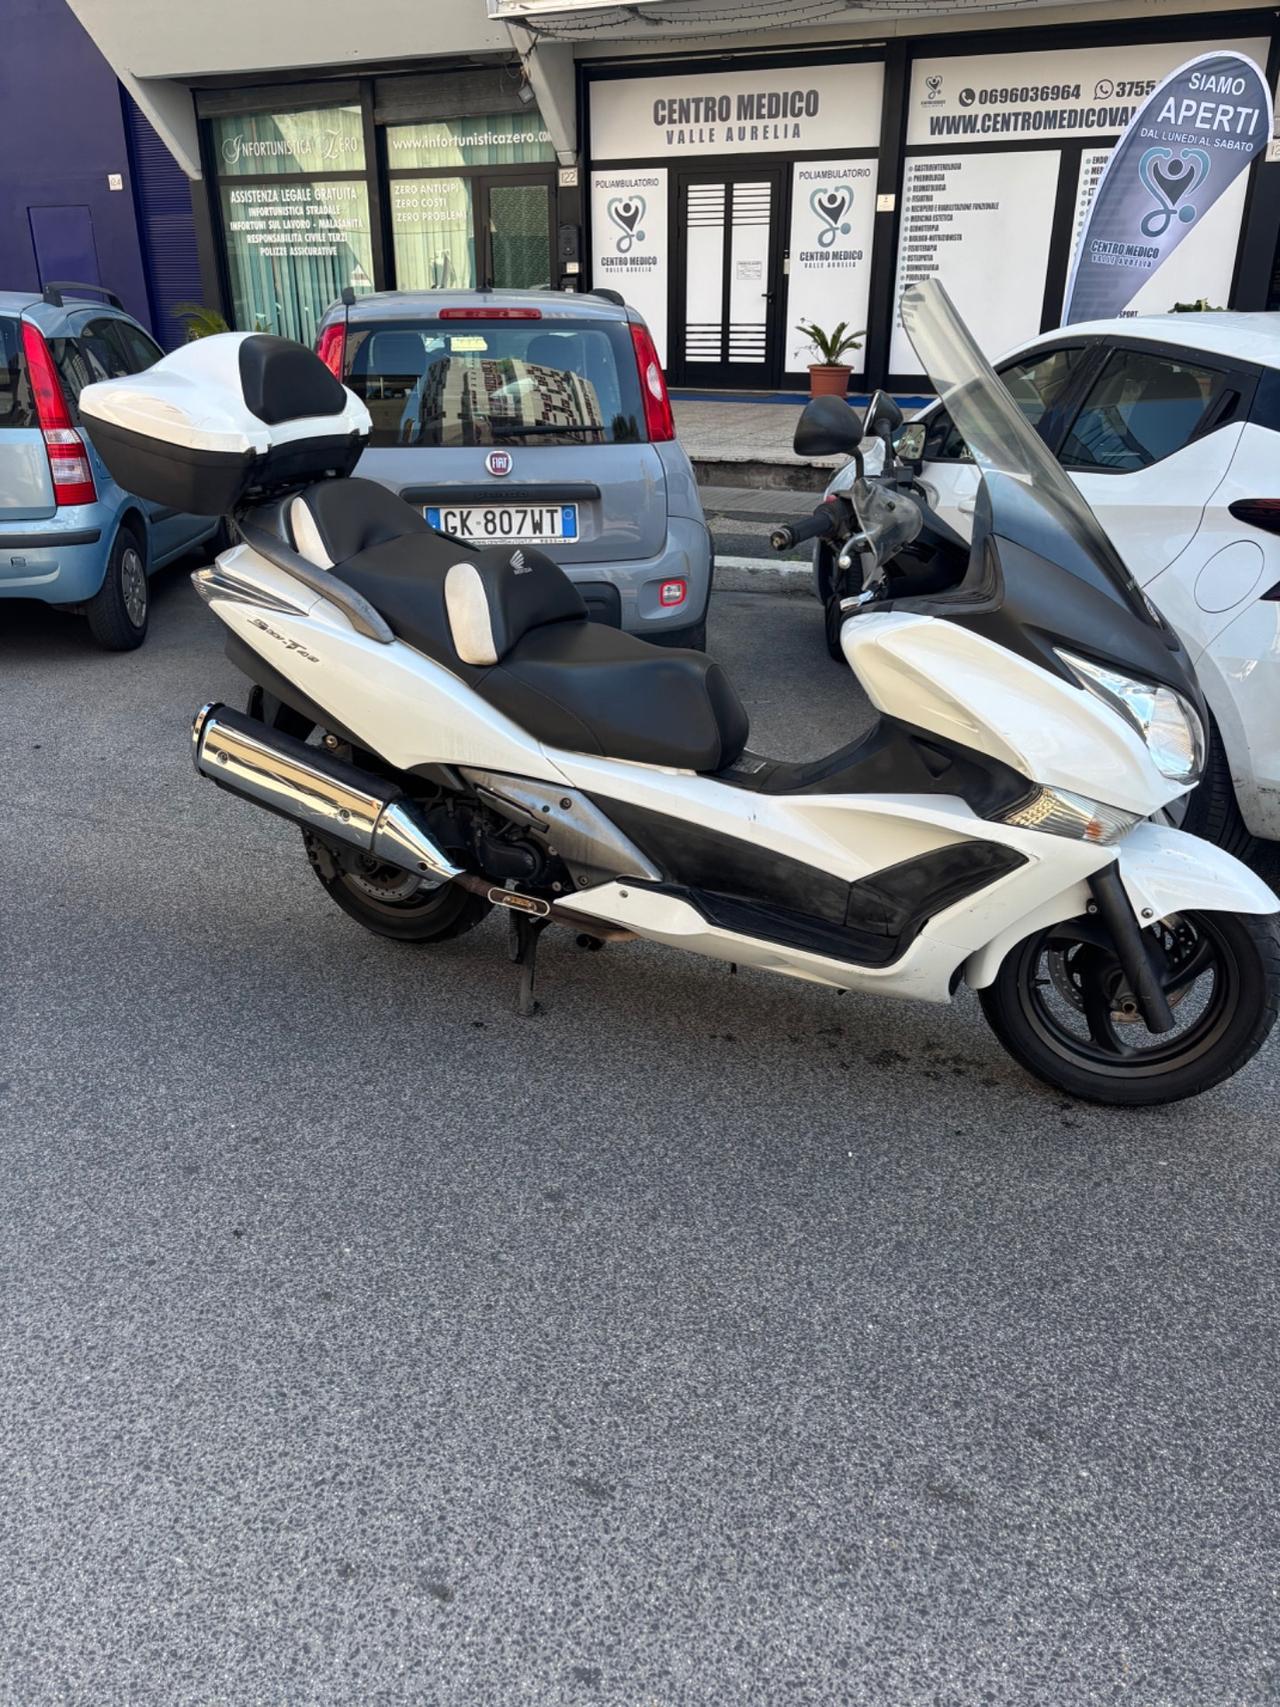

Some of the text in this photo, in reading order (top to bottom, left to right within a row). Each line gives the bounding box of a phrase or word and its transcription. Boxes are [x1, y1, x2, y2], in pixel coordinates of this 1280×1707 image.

[1189, 72, 1246, 96] SIAMO
[979, 79, 1162, 105] 0696036964 3755
[653, 89, 820, 126] CENTRO MEDICO
[1156, 96, 1260, 136] APERTI
[666, 123, 802, 145] VALLE AURELIA
[1140, 127, 1160, 140] DAL
[1199, 135, 1211, 147] AL
[1213, 137, 1254, 153] SABATO
[799, 167, 871, 180] POLIAMBULATORIO
[394, 182, 460, 195] ZERO ANTICIPI
[595, 177, 660, 189] POLIAMBULATORIO
[230, 186, 357, 203] ASSISTENZA LEGALE GRATUITA
[396, 197, 447, 209] ZERO COSTI
[248, 204, 341, 217] INFORTUNISTICA STRADALE
[397, 211, 419, 223] ZERO
[230, 220, 266, 231] INFORTUNI
[269, 220, 281, 230] SUL
[283, 219, 311, 230] LAVORO
[304, 232, 326, 243] CIVILE
[328, 232, 348, 242] TERZI
[260, 245, 337, 257] POLIZZE ASSICURATIVE
[799, 249, 863, 262] CENTRO MEDICO
[1090, 240, 1160, 259] CENTRO MEDICO
[601, 255, 658, 267] CENTRO MEDICO
[491, 456, 508, 470] FIAT
[443, 508, 559, 537] GK 807WT
